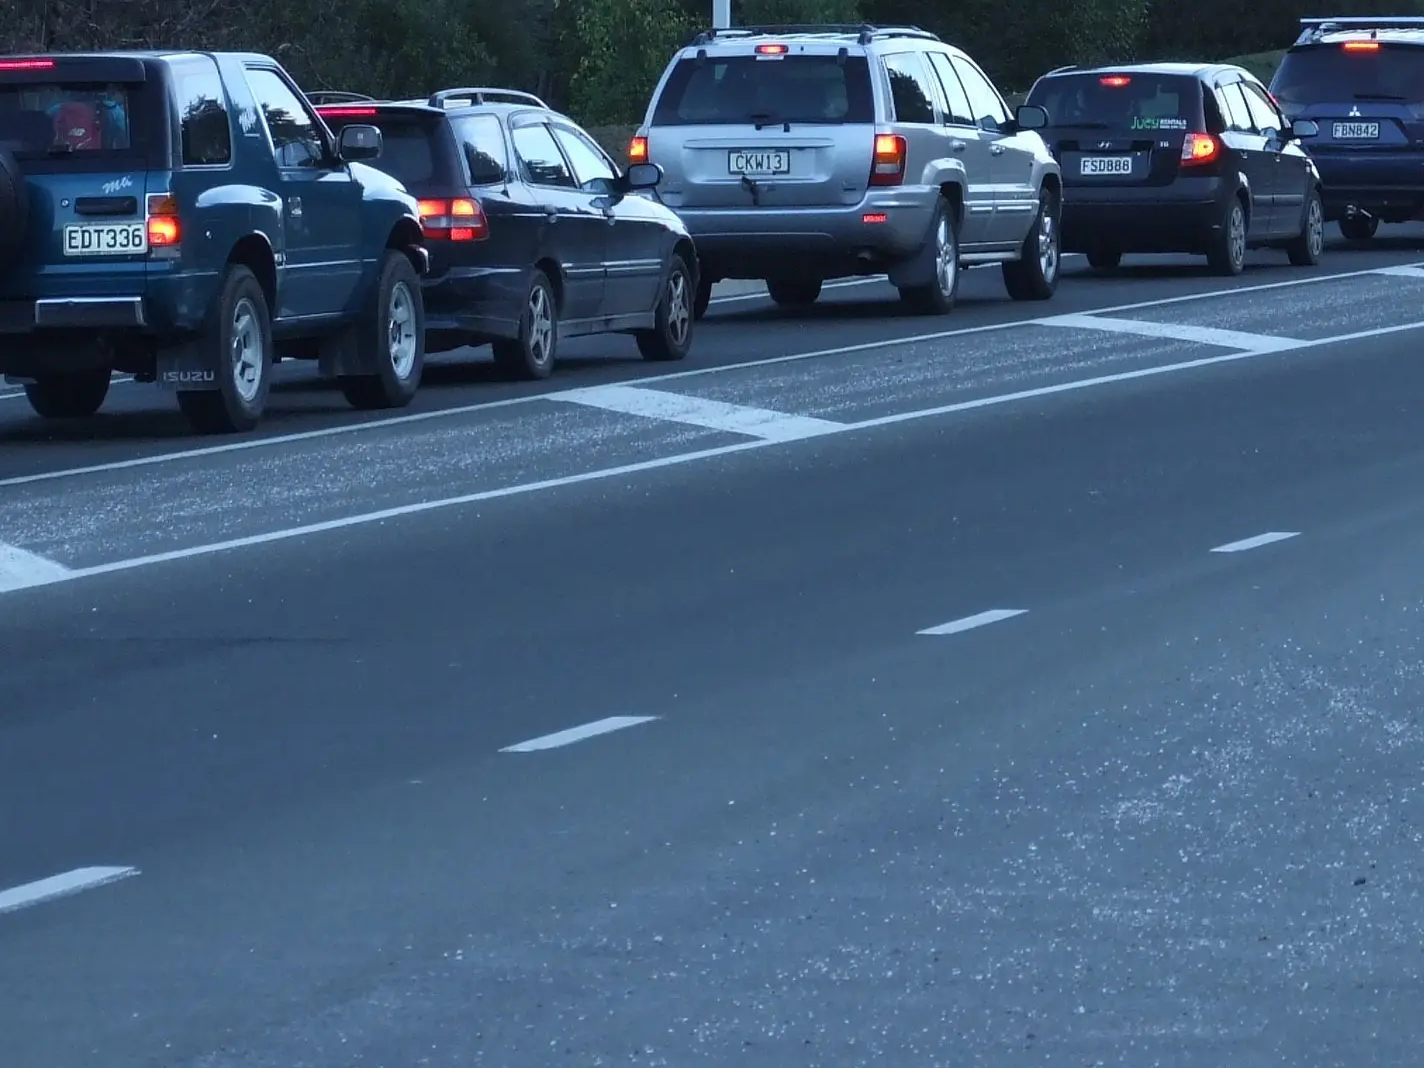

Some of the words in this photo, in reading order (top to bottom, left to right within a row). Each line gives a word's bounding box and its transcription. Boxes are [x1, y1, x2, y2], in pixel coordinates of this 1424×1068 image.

[736, 154, 782, 170] CKW13
[68, 228, 143, 249] EDT336
[162, 371, 215, 382] ISUZU
